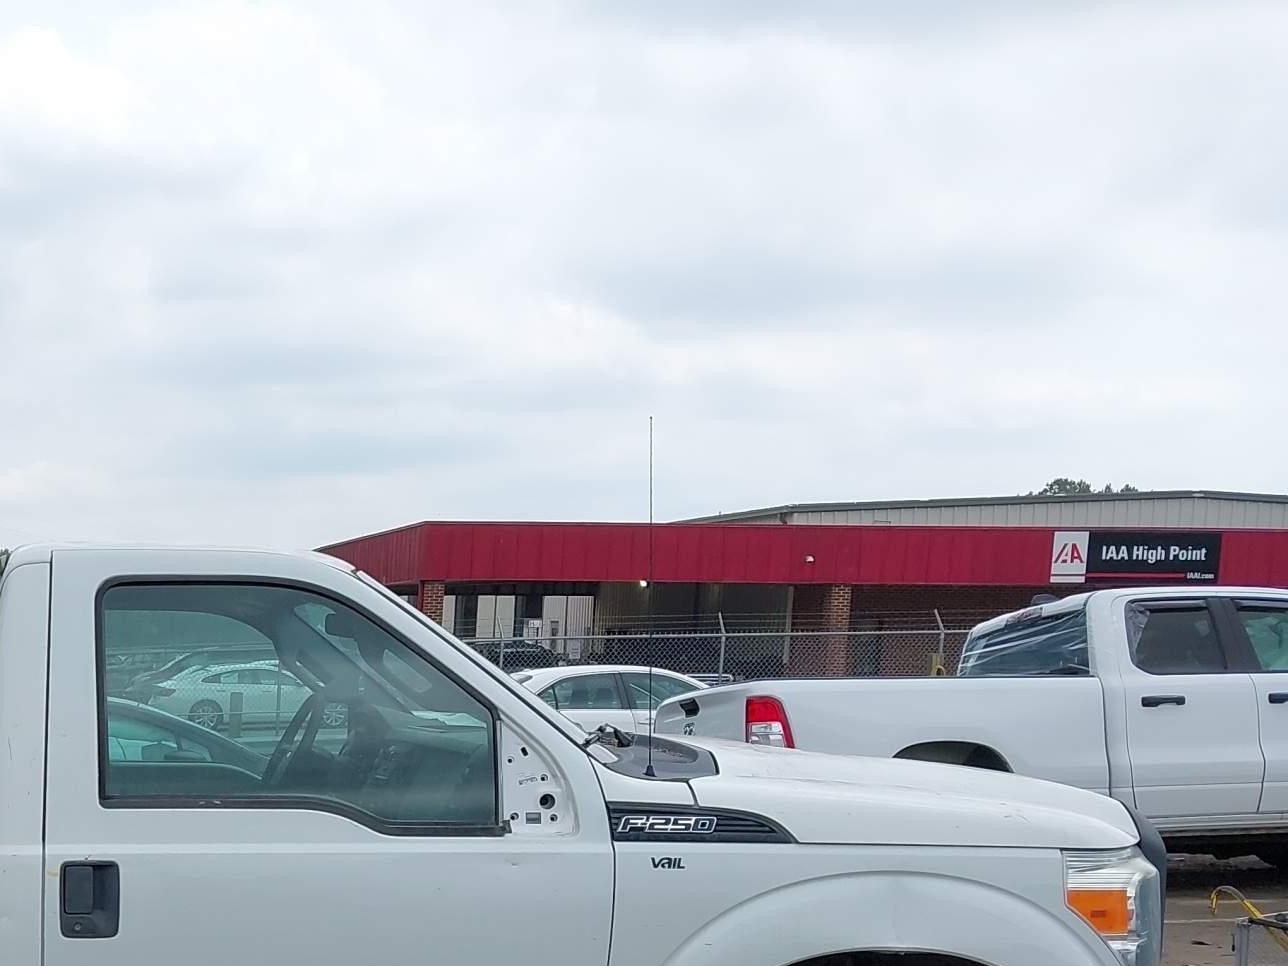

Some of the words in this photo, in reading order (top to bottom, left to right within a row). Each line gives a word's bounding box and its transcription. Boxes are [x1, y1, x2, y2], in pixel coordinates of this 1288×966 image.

[1101, 545, 1128, 561] IAA
[1132, 545, 1165, 564] High
[1169, 546, 1207, 561] Point
[617, 815, 717, 834] F-250
